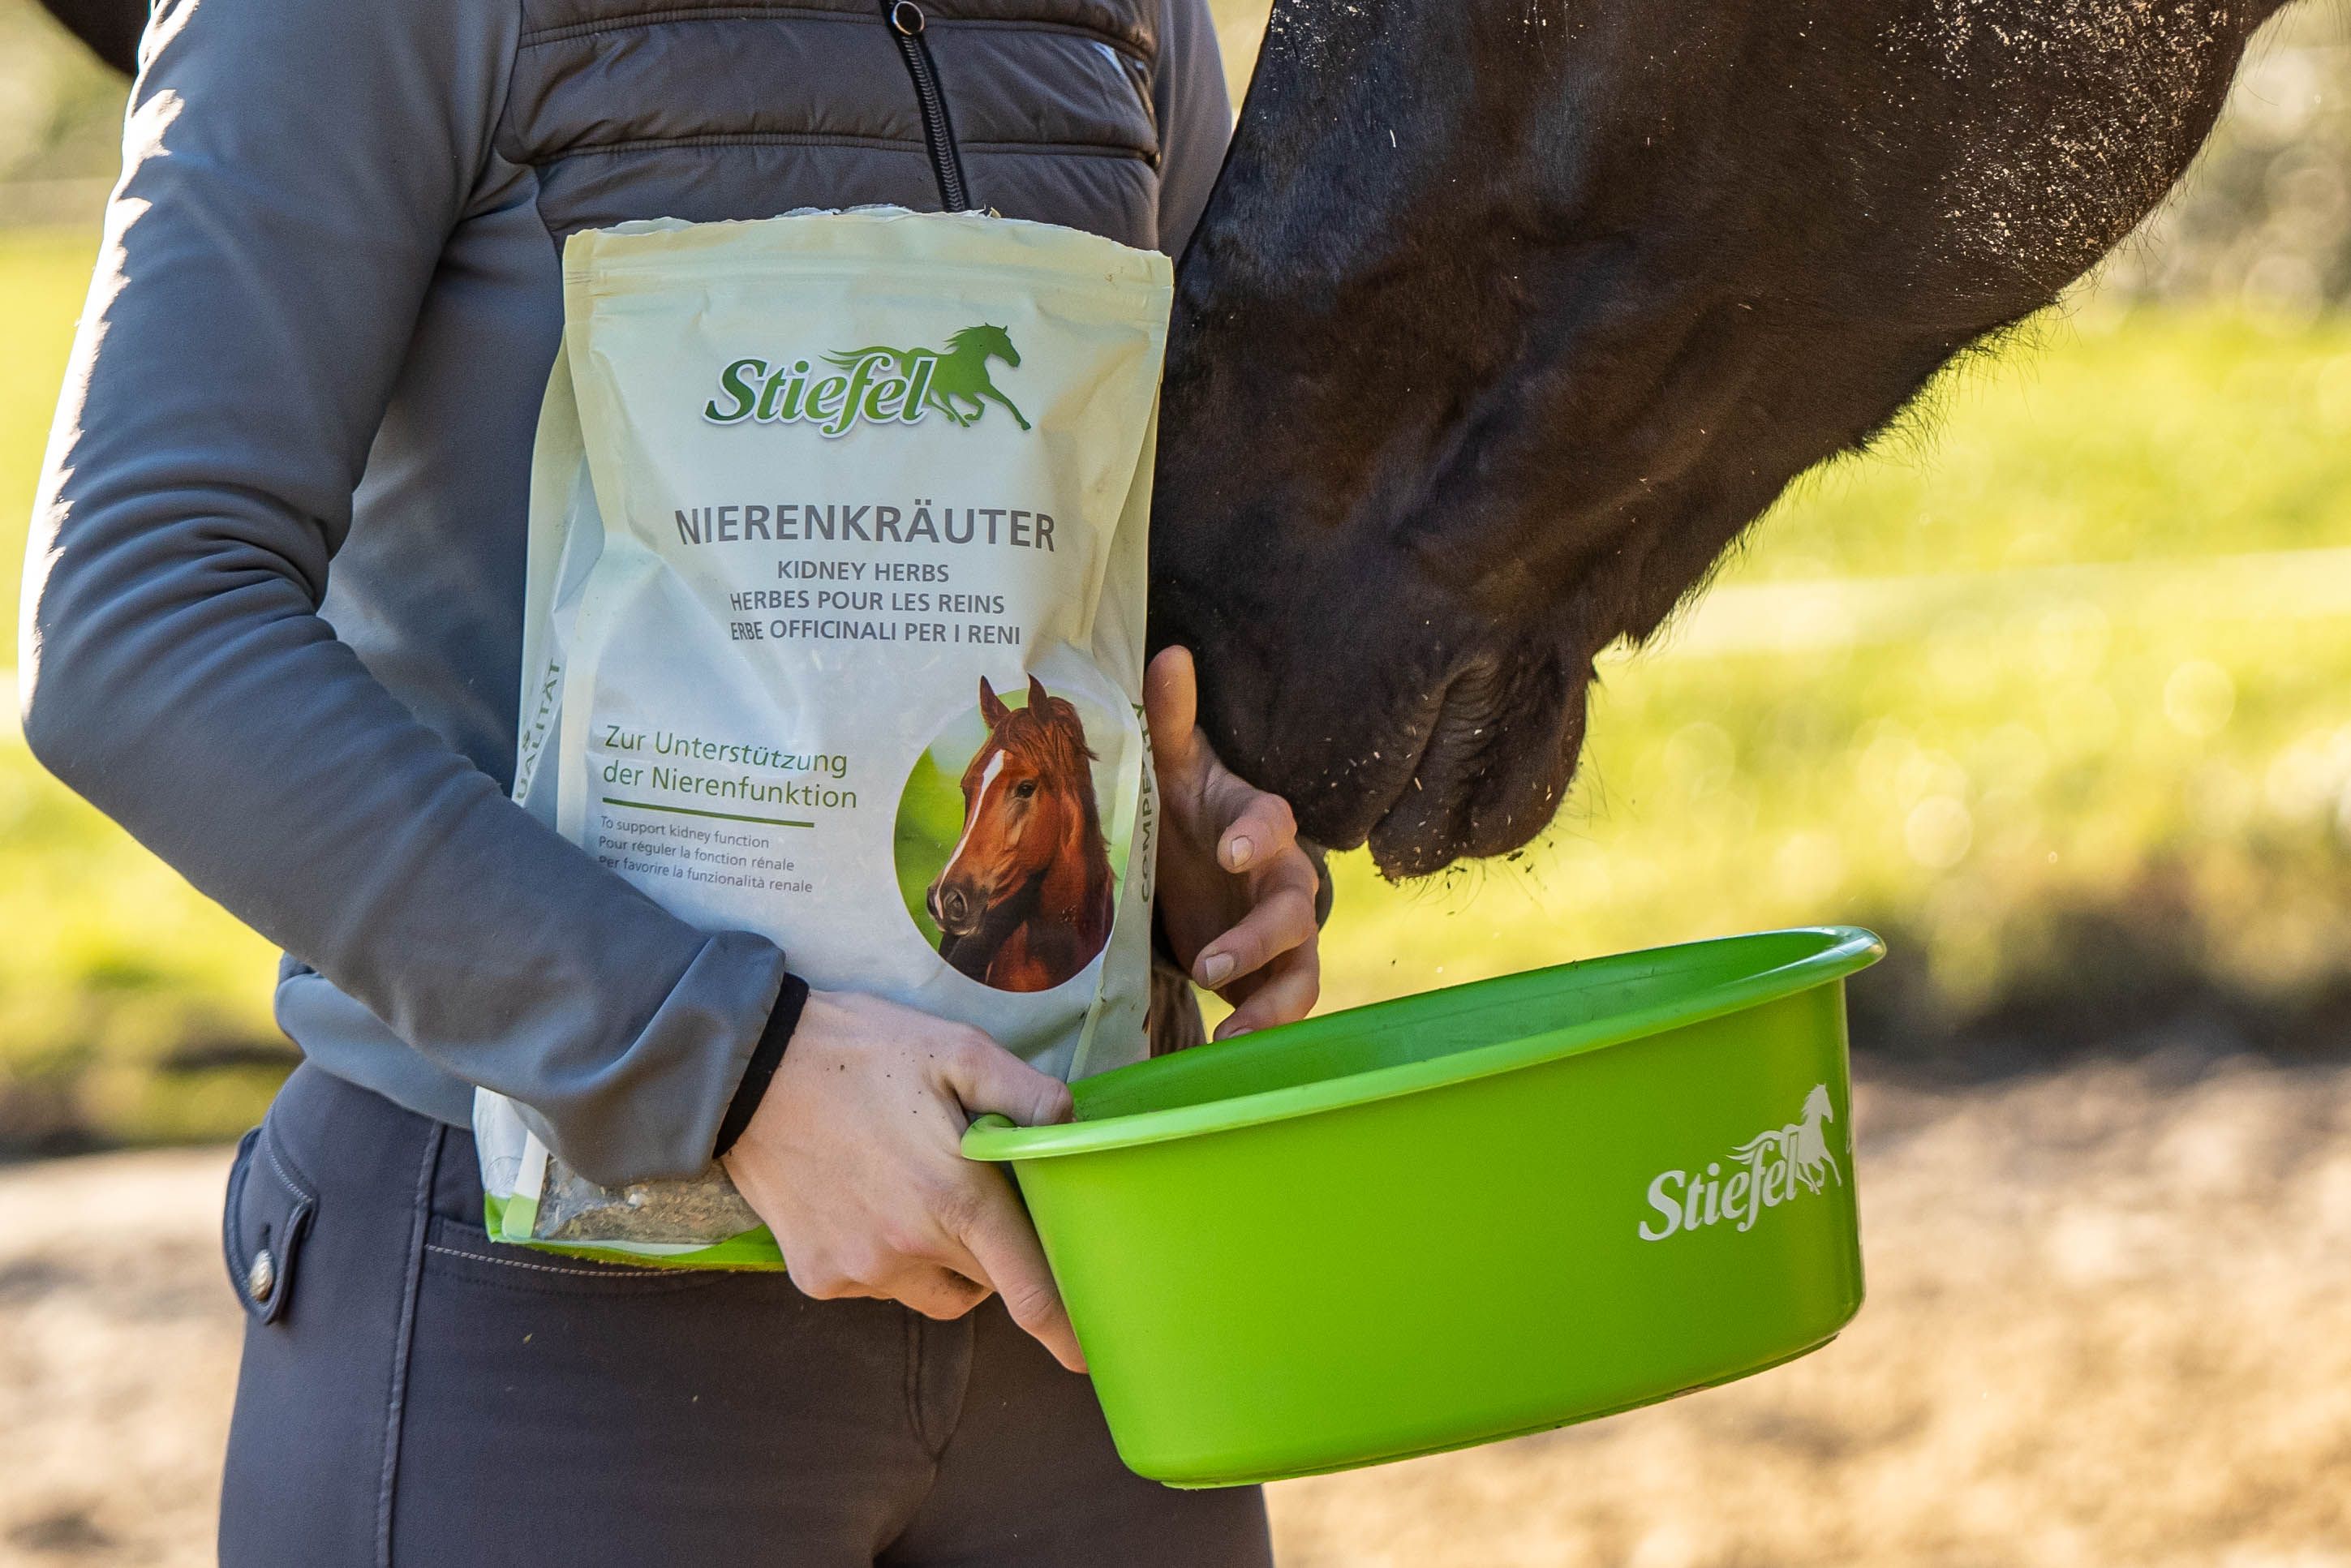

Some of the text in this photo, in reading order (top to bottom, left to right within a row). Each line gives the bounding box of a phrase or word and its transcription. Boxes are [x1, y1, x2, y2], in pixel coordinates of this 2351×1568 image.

[703, 353, 938, 439] Stiefel
[675, 499, 1055, 552] NIERENKRÄUTER
[777, 561, 949, 582] KIDNEY HERBS
[730, 590, 1004, 614] HERBES POUR LES REINS
[730, 620, 1020, 645] ERBE OFFICINALI PER I RENI
[516, 657, 560, 799] UALITÄT
[604, 724, 847, 779] Zur Unterstützung
[603, 759, 857, 809] der Nierenfunktion
[600, 815, 770, 848] To support kidney function
[599, 836, 795, 871] Pour réguler la fonction rénale
[623, 857, 669, 877] favorire
[673, 865, 683, 879] la
[687, 866, 765, 890] funzionalità
[769, 879, 813, 893] renale
[1639, 1132, 1799, 1243] Stiefel
